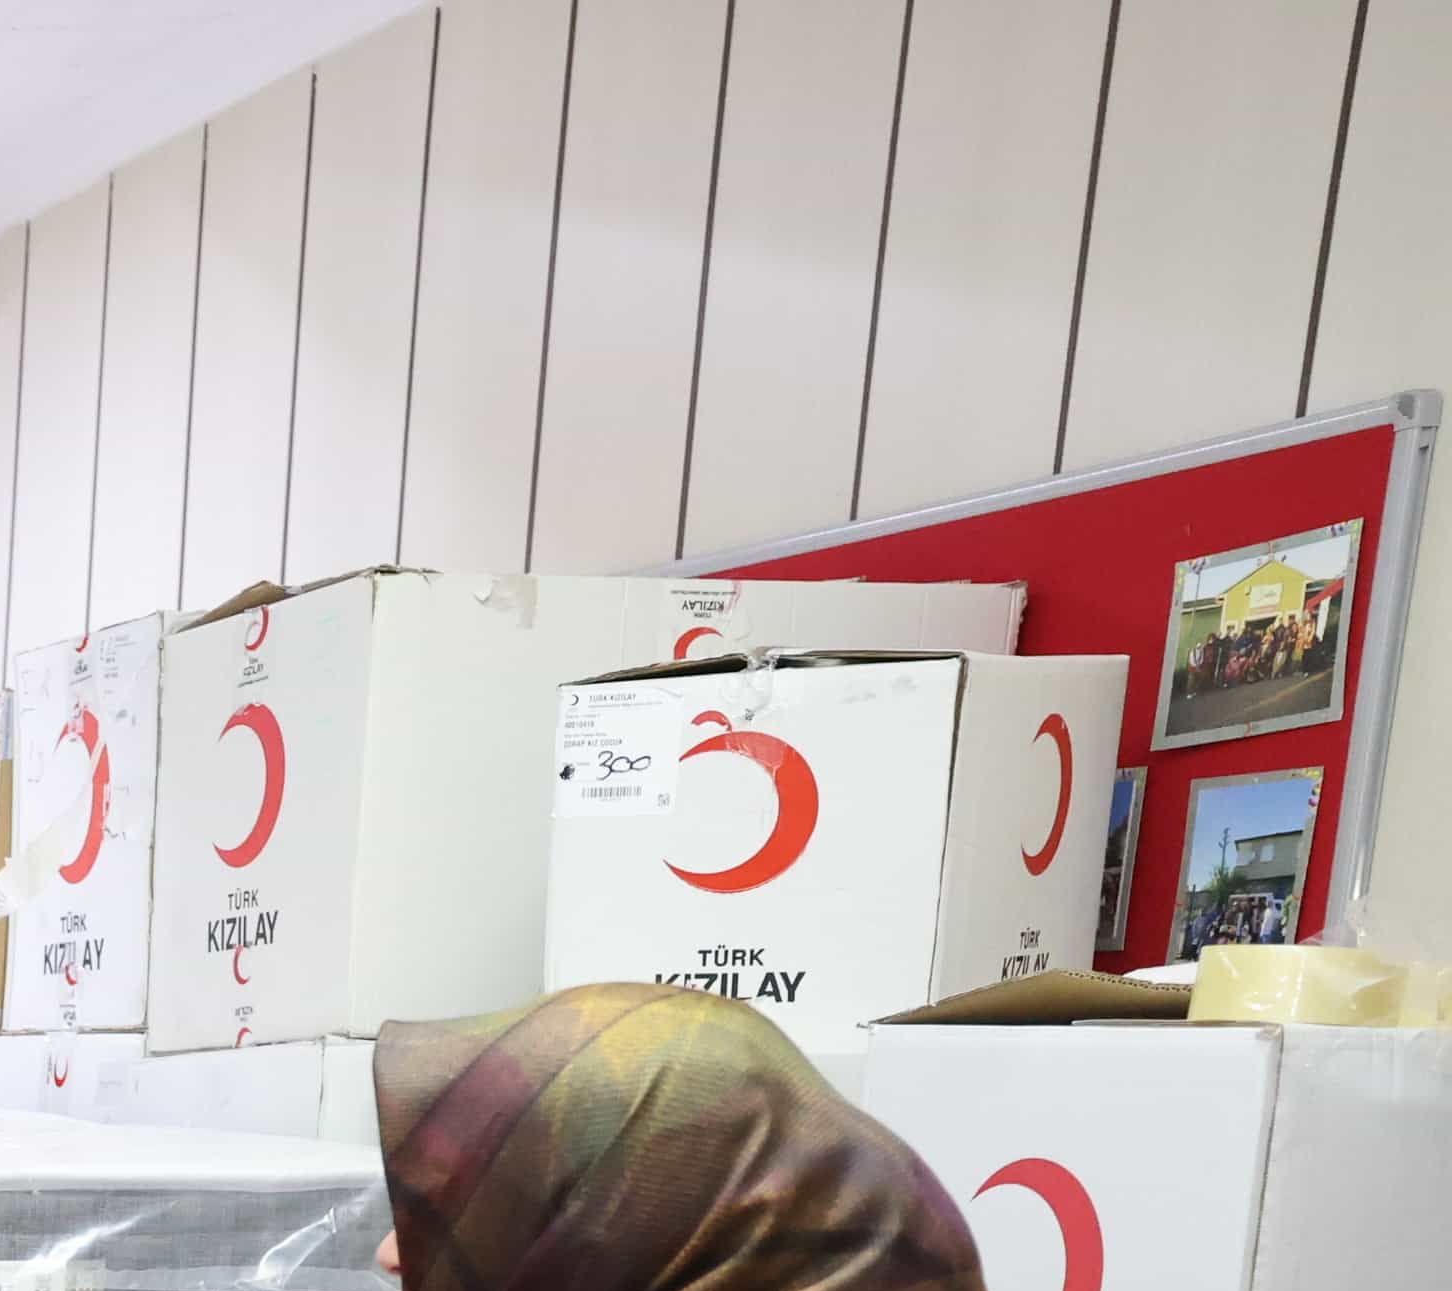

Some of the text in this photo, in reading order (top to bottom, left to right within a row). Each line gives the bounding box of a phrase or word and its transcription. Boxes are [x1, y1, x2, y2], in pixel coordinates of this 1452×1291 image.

[596, 750, 652, 782] 300
[227, 887, 260, 912] TÜRK
[60, 911, 87, 935] TÜRK
[207, 910, 279, 953] KIZILAY
[697, 944, 765, 967] TÜRK
